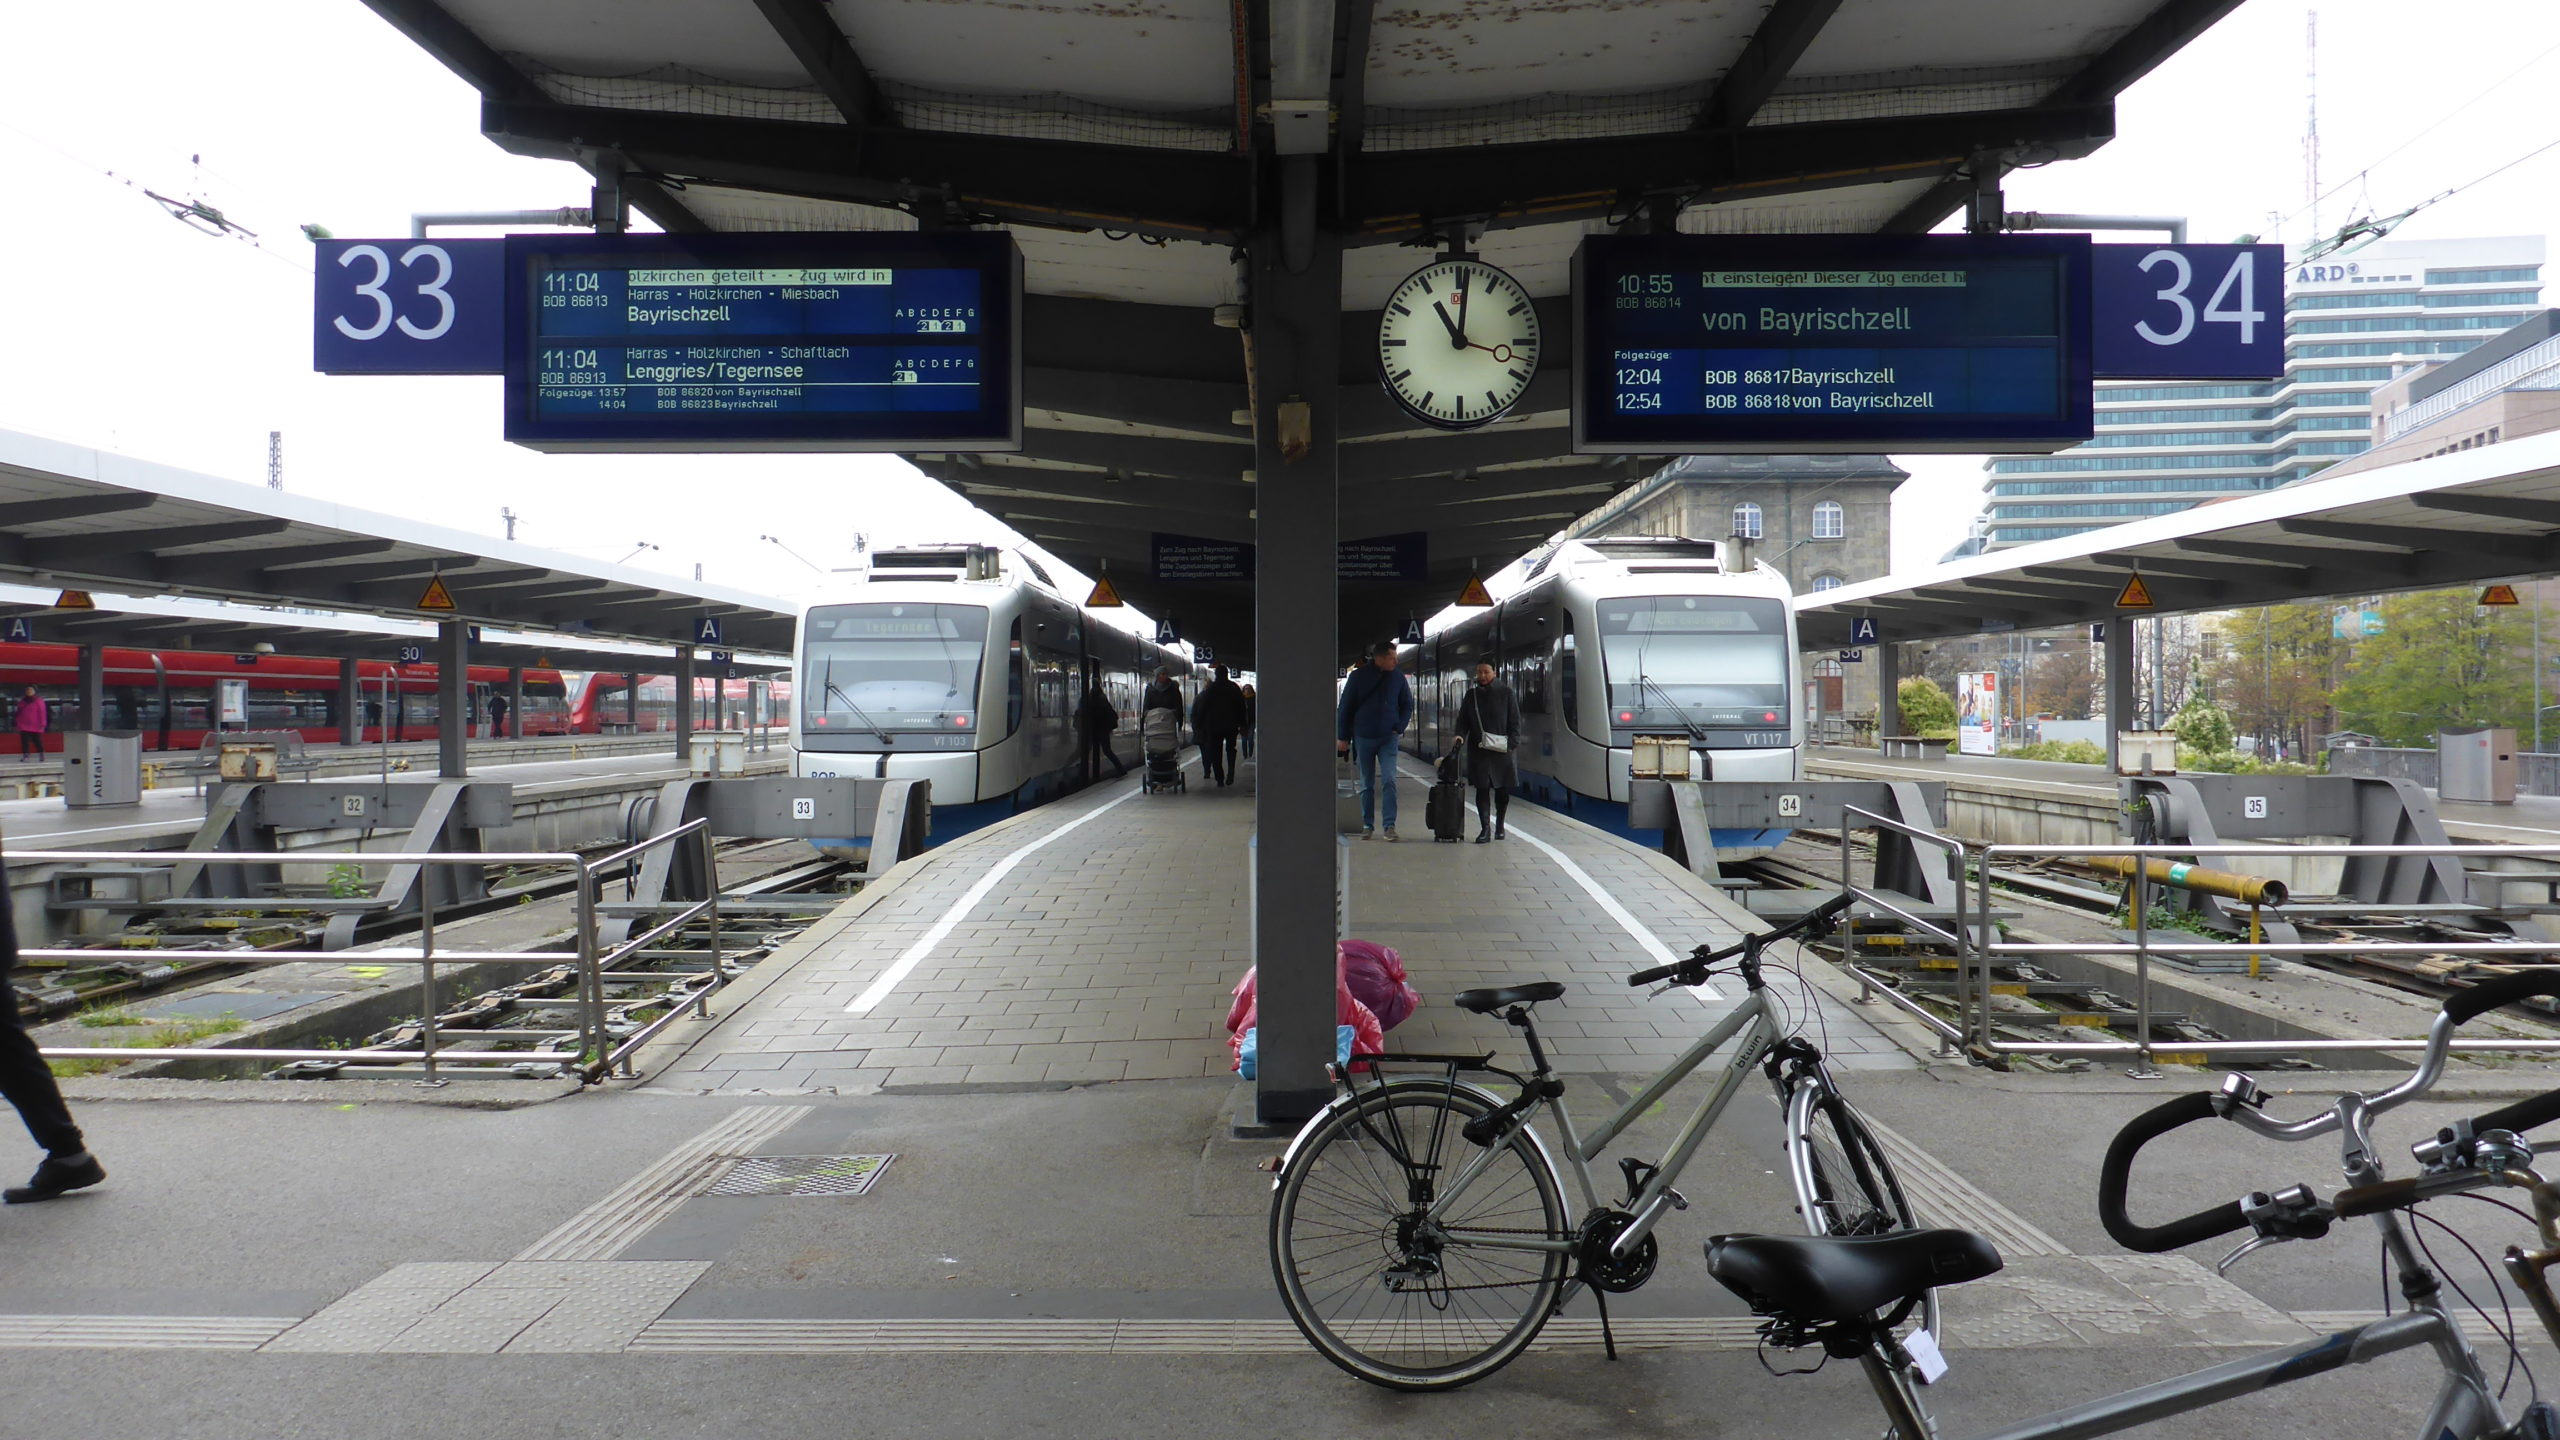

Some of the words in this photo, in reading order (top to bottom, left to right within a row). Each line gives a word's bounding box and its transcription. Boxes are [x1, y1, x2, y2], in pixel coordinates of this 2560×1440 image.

[545, 273, 599, 292] 11:04
[712, 270, 764, 284] geteilt
[800, 270, 826, 284] Zug
[833, 270, 865, 281] wird
[872, 270, 885, 281] in
[1616, 274, 1673, 294] 10:55
[1723, 272, 1808, 286] einsteigen!
[1814, 272, 1860, 283] Dieser
[1868, 271, 1895, 286] Zug
[1902, 271, 1947, 283] endet
[2296, 266, 2345, 282] ARD
[333, 244, 456, 340] 33
[543, 295, 566, 307] BOB
[572, 295, 608, 307] 86813
[628, 289, 669, 300] Harras
[689, 288, 762, 300] Holzkirchen
[782, 288, 839, 300] Miesbach
[2134, 250, 2266, 345] 34
[628, 306, 730, 325] Bayrischzell
[896, 308, 903, 317] A
[908, 308, 914, 317] B
[920, 308, 926, 317] C
[932, 308, 939, 317] D
[944, 308, 950, 317] E
[956, 308, 962, 317] F
[968, 308, 974, 317] G
[1616, 297, 1639, 309] BOB
[1645, 297, 1681, 309] 86814
[1702, 312, 1747, 330] von
[1760, 307, 1911, 336] Bayrischzell
[543, 350, 598, 369] 11:04
[626, 348, 668, 360] Harras
[688, 347, 760, 359] Holzkirchen
[780, 346, 850, 359] Schaftlach
[895, 359, 903, 368] A
[908, 359, 914, 368] B
[920, 359, 926, 368] C
[932, 359, 938, 368] D
[944, 359, 950, 368] E
[956, 359, 962, 368] F
[967, 359, 974, 368] G
[1614, 350, 1672, 362] Folgezüge:
[542, 372, 564, 384] BOB
[570, 372, 606, 384] 86913
[626, 362, 804, 382] Lenggries/Tegernsee
[1616, 369, 1662, 385] 12:04
[1705, 370, 1737, 384] BOB
[1744, 370, 1790, 384] 86817
[1792, 368, 1895, 388] Bayrischzell
[539, 388, 596, 399] Folgezüge:
[658, 388, 677, 397] BOB
[738, 387, 802, 398] Bayrischzell
[1616, 393, 1662, 409] 12:54
[1705, 395, 1737, 408] BOB
[1744, 395, 1790, 408] 86818
[1792, 396, 1821, 408] von
[1830, 392, 1934, 412] Bayrischzell
[658, 400, 677, 408] BOB
[714, 400, 778, 410] Bayrischzell
[11, 618, 26, 637] A
[701, 619, 717, 638] A
[1159, 619, 1174, 638] A
[1406, 620, 1421, 639] A
[1858, 619, 1874, 638] A
[401, 647, 420, 660] 30
[1196, 647, 1214, 660] 33
[729, 669, 736, 678] B
[1231, 668, 1238, 677] B
[934, 736, 945, 746] VT
[950, 736, 966, 746] 103
[1744, 733, 1758, 745] VT
[1762, 733, 1782, 745] 117
[93, 756, 103, 798] Abfall
[347, 798, 361, 812] 32
[797, 801, 810, 814] 33
[1782, 798, 1797, 811] 34
[2249, 800, 2262, 813] 35
